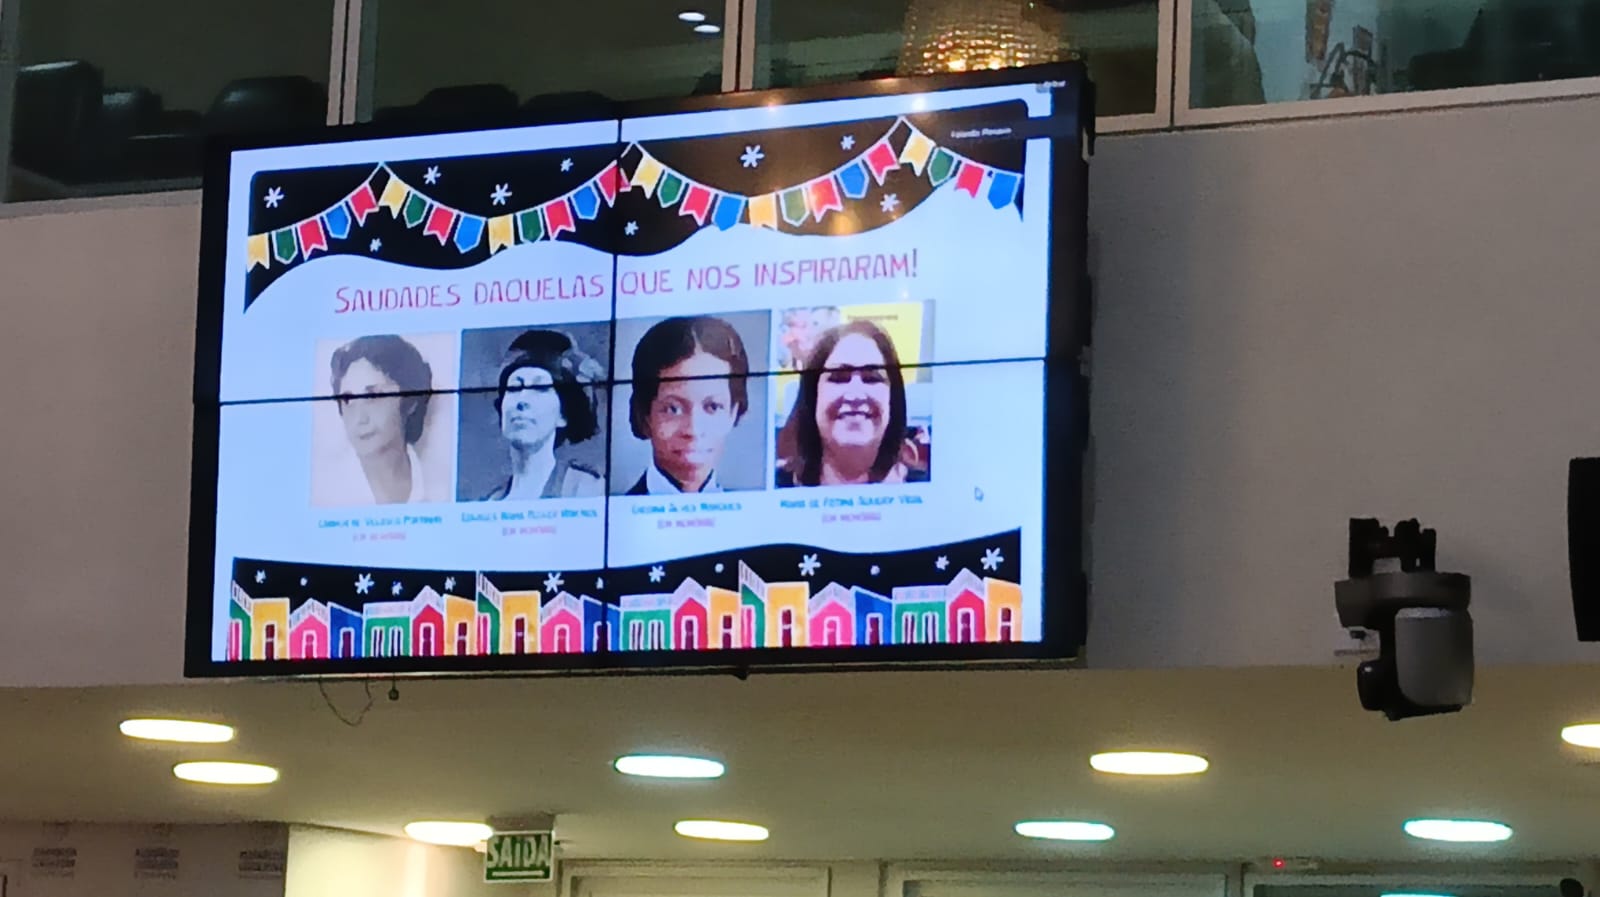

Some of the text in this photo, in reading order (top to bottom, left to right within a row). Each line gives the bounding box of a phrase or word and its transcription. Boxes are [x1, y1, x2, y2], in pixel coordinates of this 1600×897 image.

[334, 283, 461, 313] SAUDADES
[620, 269, 674, 295] QUE
[687, 264, 741, 291] NOS
[754, 248, 918, 287] INSPIRARAM!
[486, 833, 551, 868] SAÍDA
